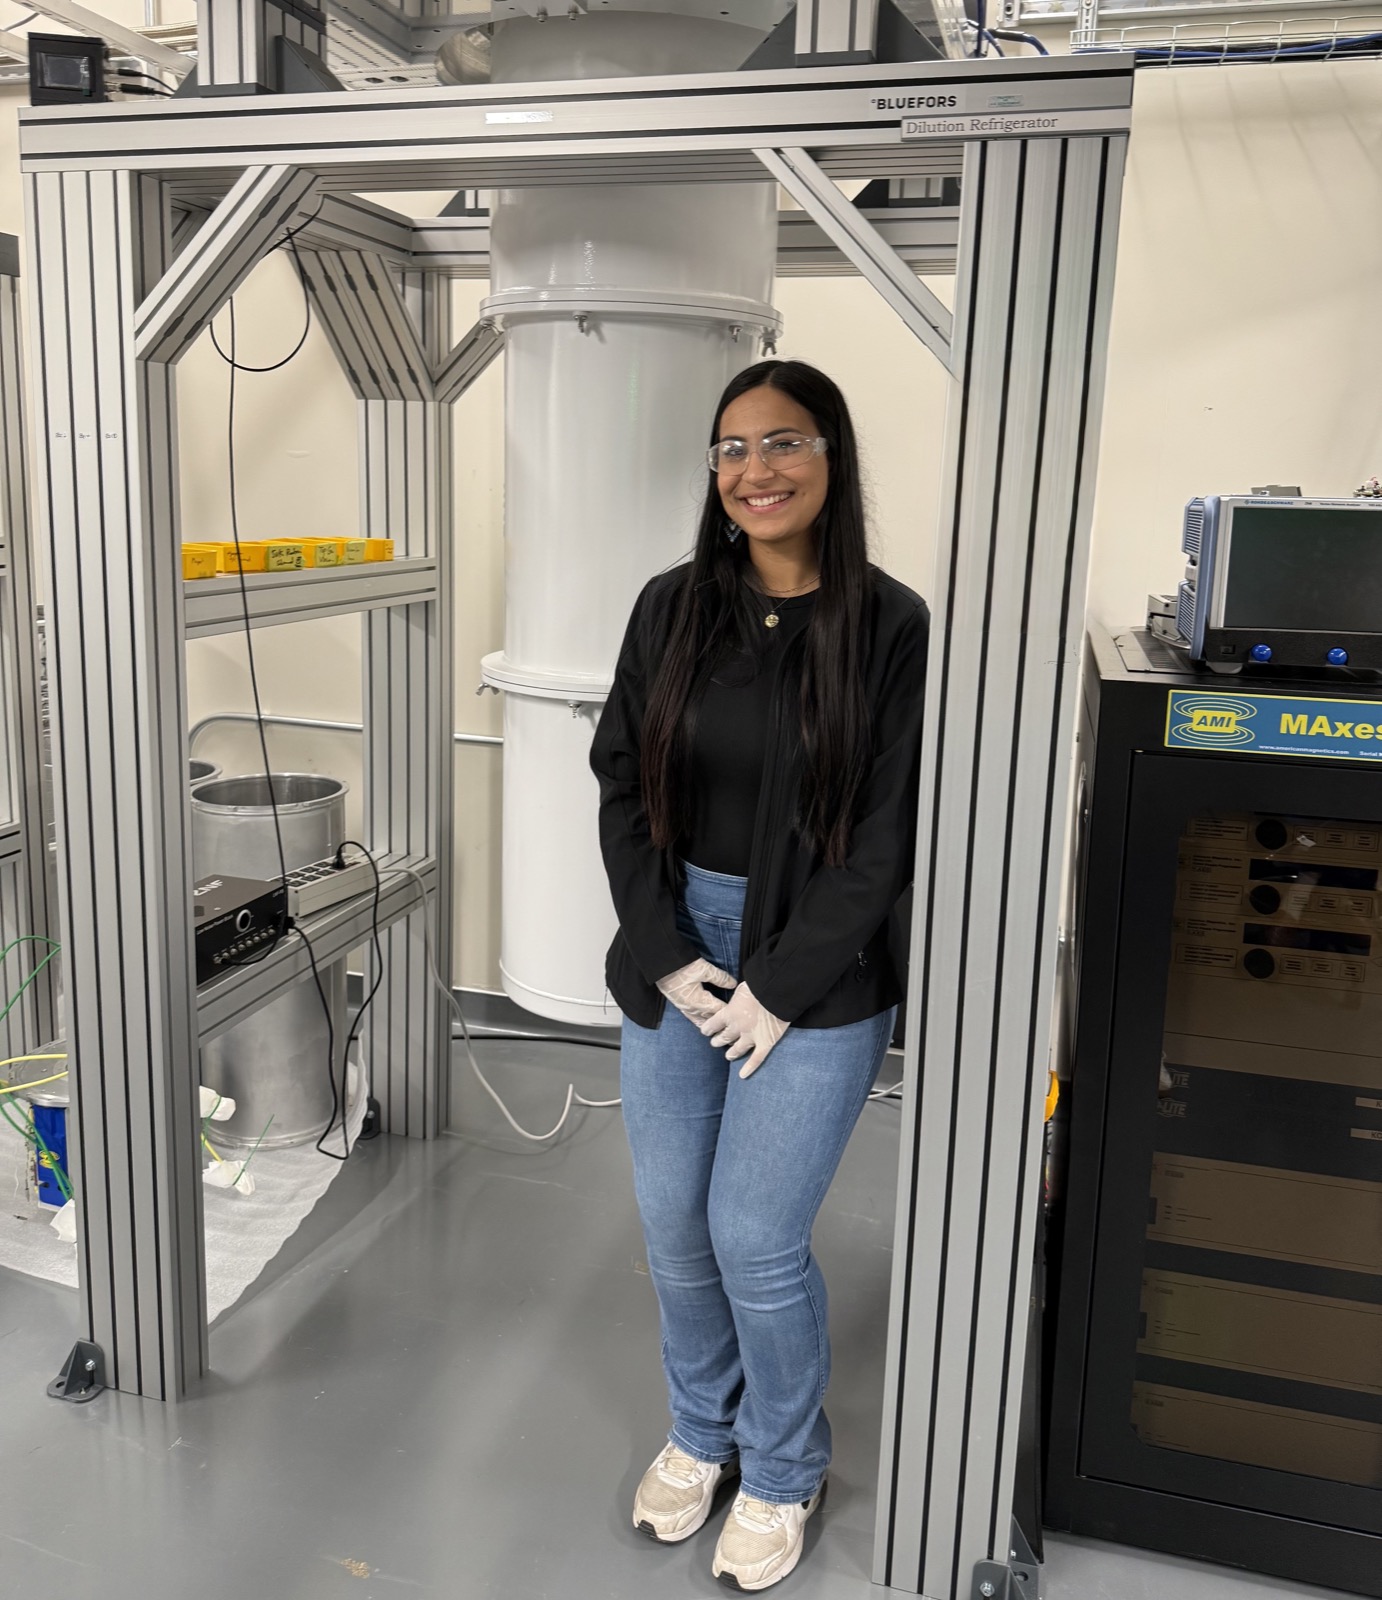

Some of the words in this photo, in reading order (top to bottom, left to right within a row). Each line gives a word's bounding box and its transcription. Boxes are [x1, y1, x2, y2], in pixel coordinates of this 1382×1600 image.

[876, 95, 957, 110] BLUEFORS
[906, 120, 965, 134] Dilution
[970, 116, 1059, 132] Refrigerator
[1196, 715, 1233, 729] AMI
